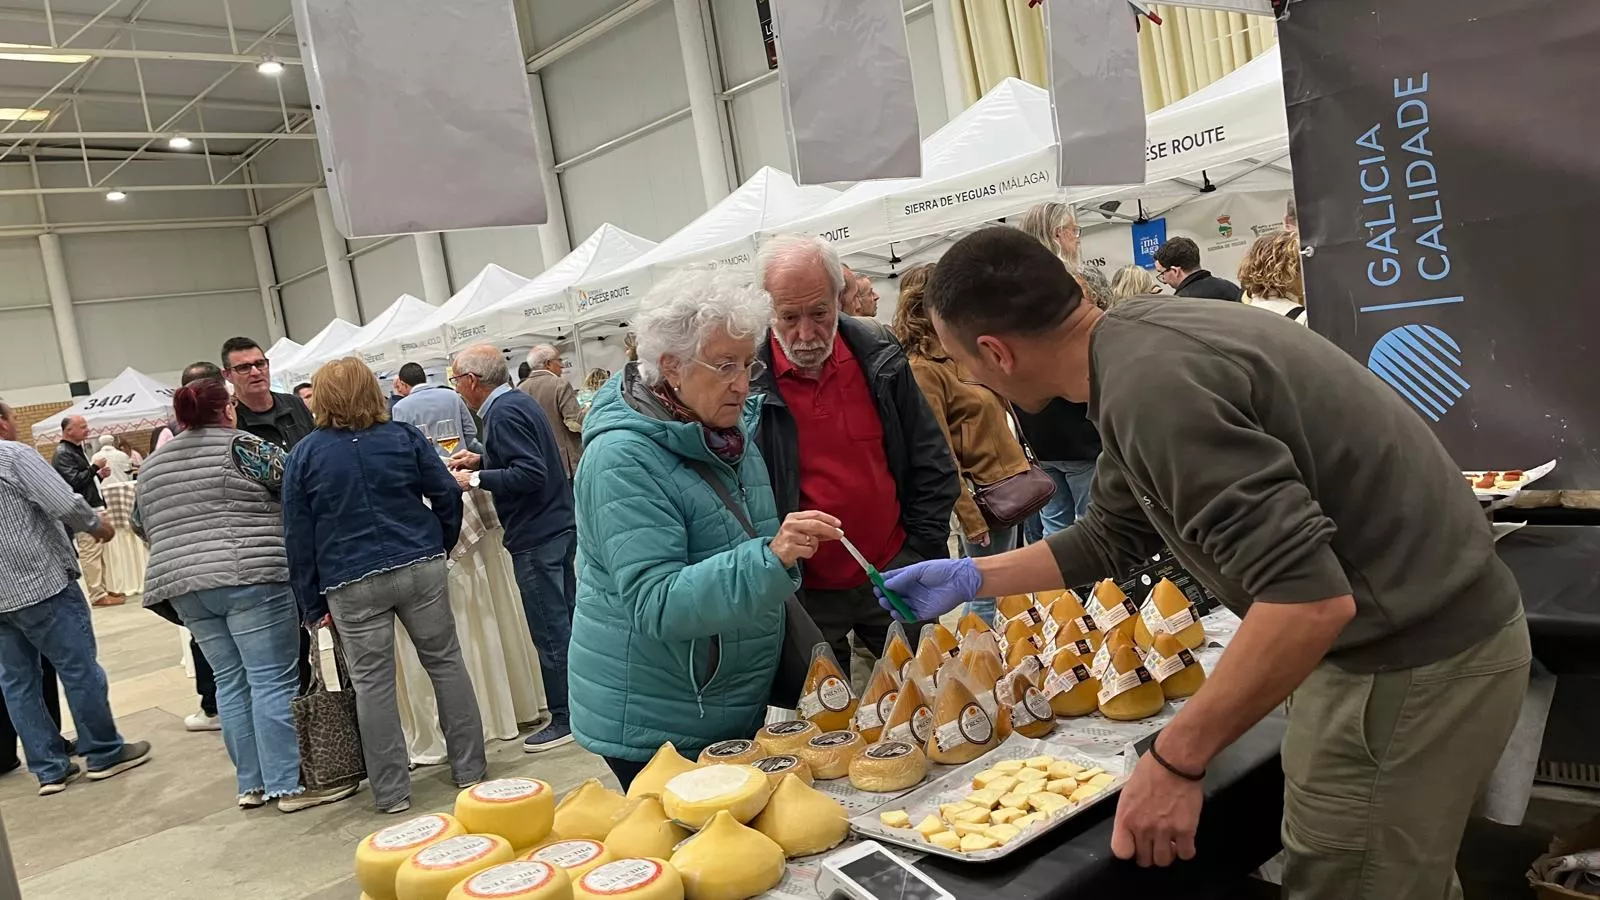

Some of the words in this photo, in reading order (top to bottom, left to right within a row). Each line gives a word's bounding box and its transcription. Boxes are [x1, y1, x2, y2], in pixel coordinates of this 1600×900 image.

[1171, 125, 1226, 155] ROUTE
[904, 199, 939, 216] SIERRA
[940, 195, 953, 207] DE
[955, 184, 997, 204] YEGUAS
[999, 170, 1050, 195] (MÁLAGA)
[1393, 71, 1452, 281] CALIDADE
[1355, 122, 1402, 287] GALICIA
[588, 291, 610, 306] CHEESE
[610, 285, 630, 299] ROUTE
[84, 393, 136, 410] 3404
